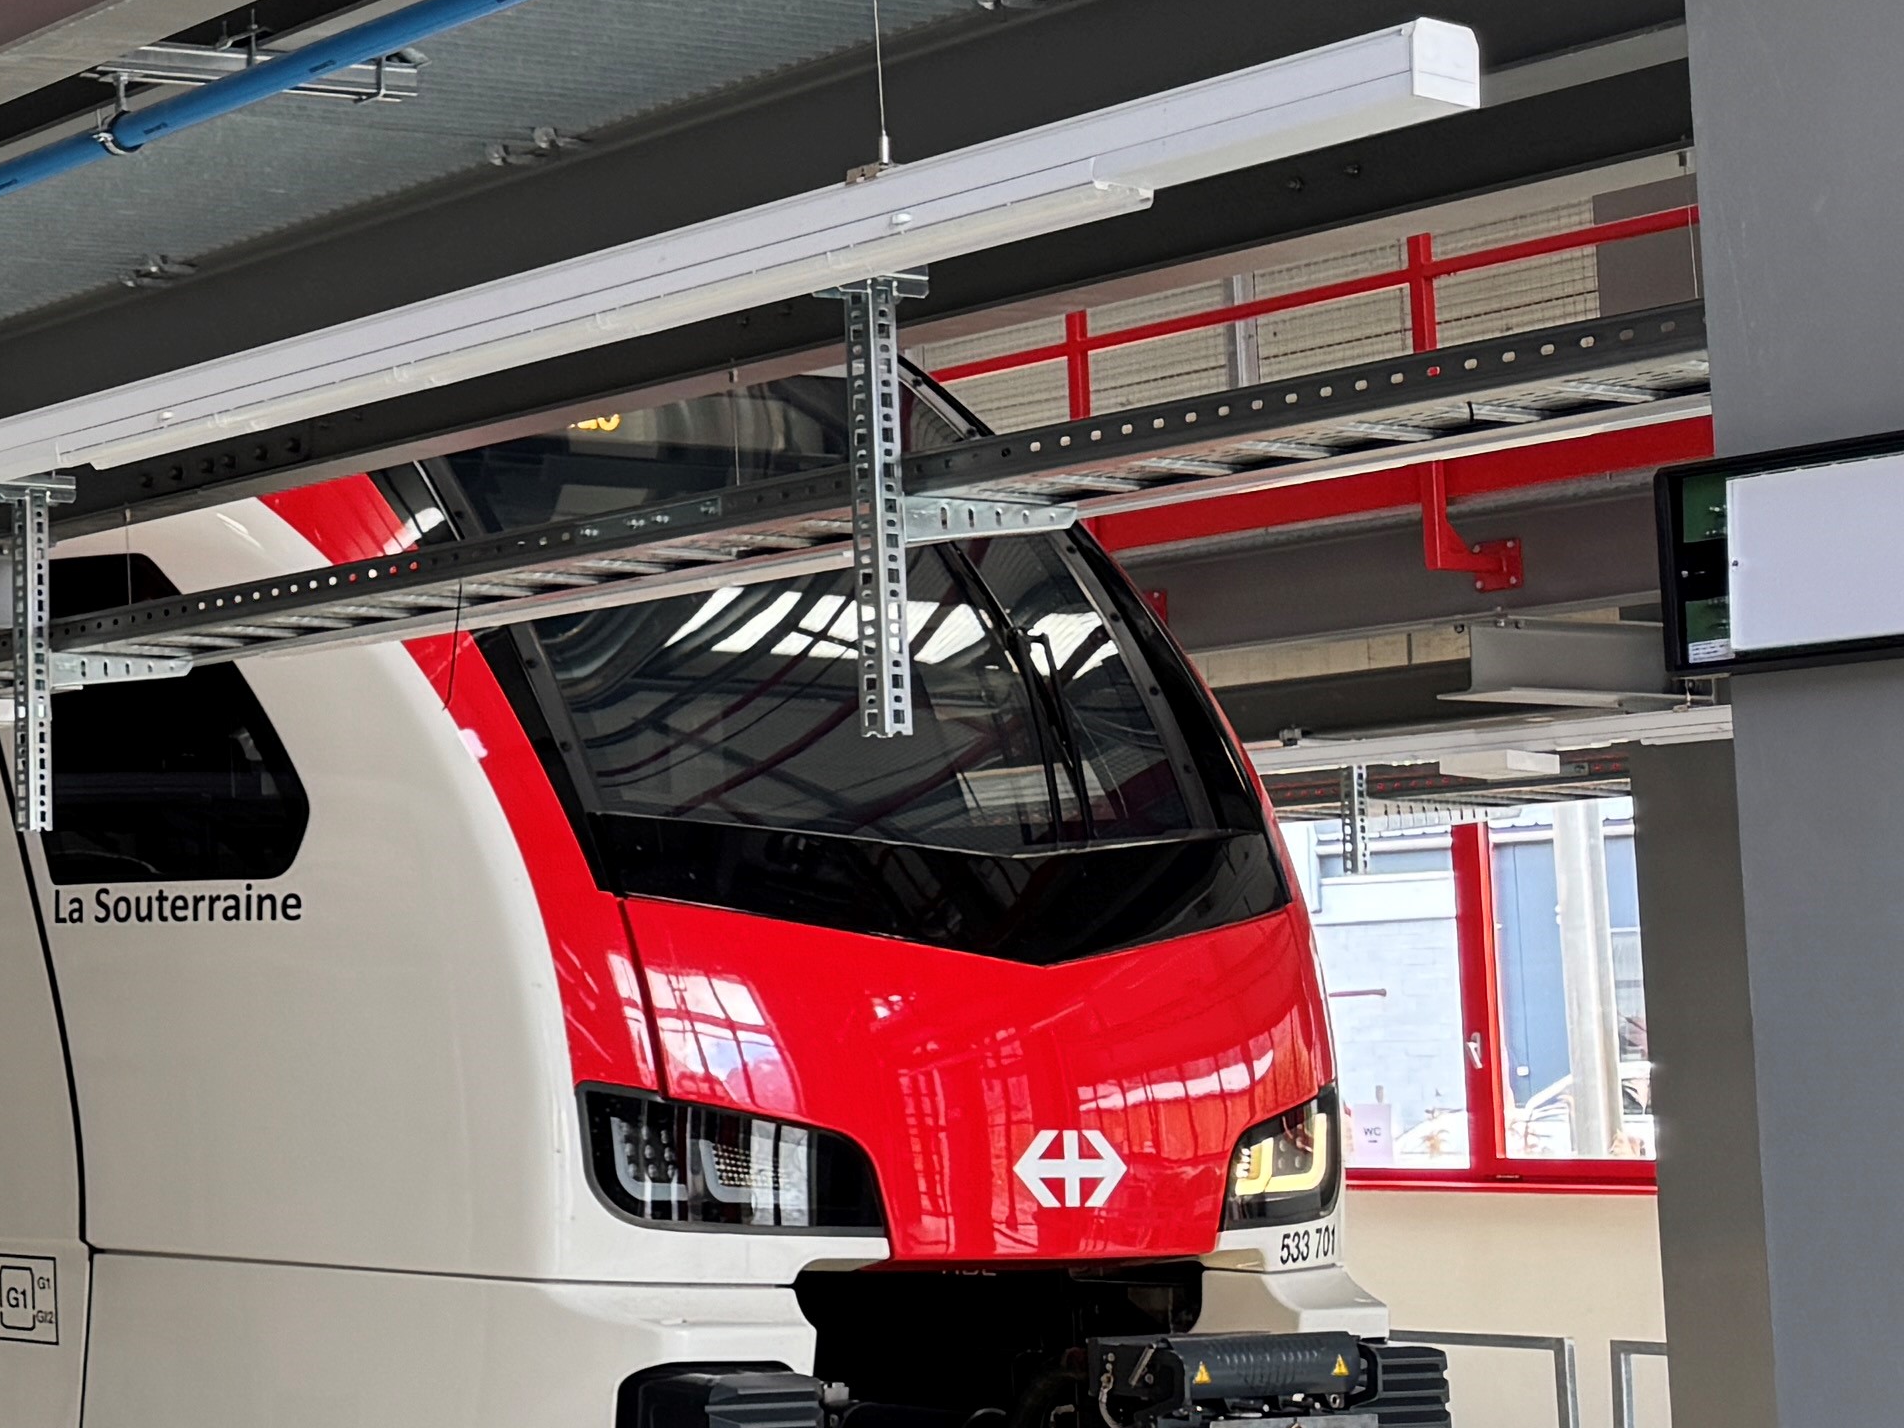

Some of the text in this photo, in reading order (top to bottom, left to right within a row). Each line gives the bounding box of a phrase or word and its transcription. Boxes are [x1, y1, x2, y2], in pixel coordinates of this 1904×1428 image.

[54, 883, 302, 924] La Souterraine
[1363, 1127, 1382, 1137] WC
[1280, 1225, 1336, 1265] 533 701
[36, 1276, 51, 1290] G1
[6, 1286, 28, 1309] G1
